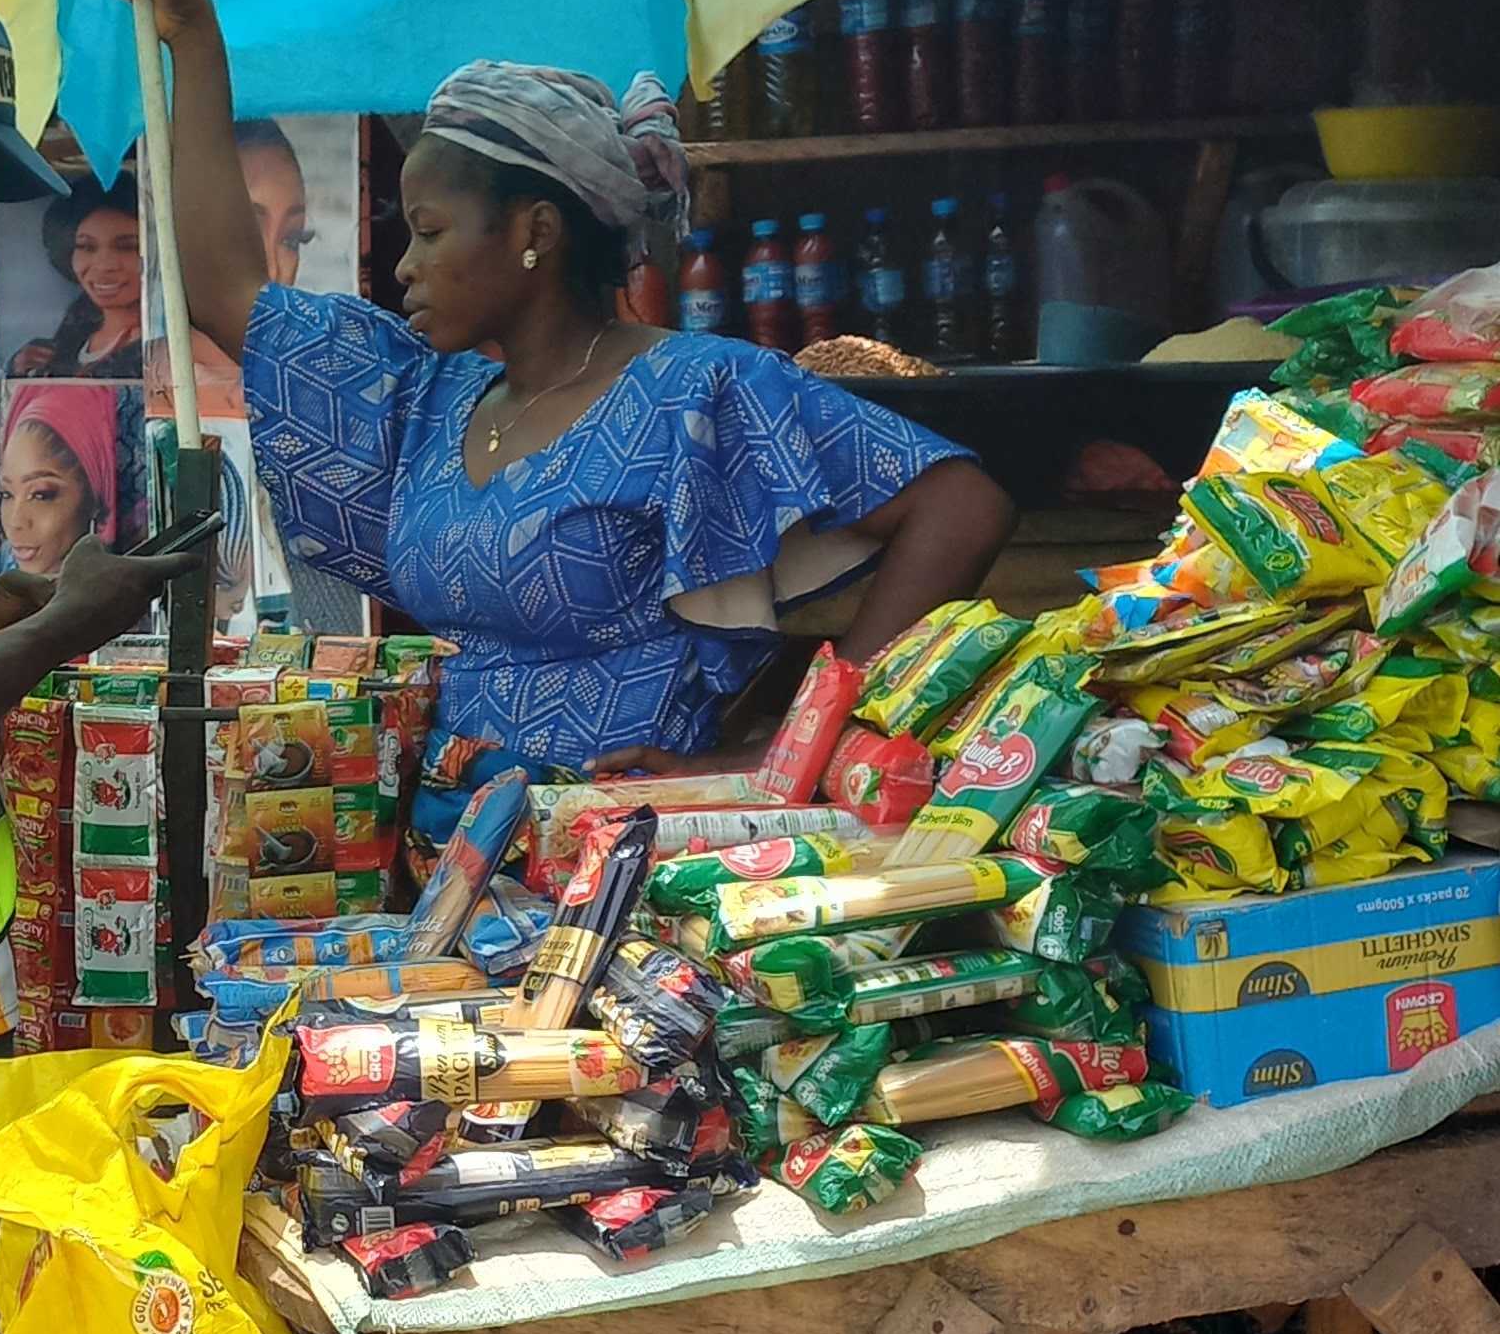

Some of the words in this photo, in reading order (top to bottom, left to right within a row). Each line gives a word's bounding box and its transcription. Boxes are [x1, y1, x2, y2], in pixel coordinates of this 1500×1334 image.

[1417, 886, 1453, 905] packs
[1360, 924, 1471, 958] SPAGHETTI
[1377, 945, 1458, 970] Premium
[1247, 969, 1298, 995] Slim
[1395, 992, 1444, 1011] CROWN
[1252, 1060, 1304, 1085] Slim
